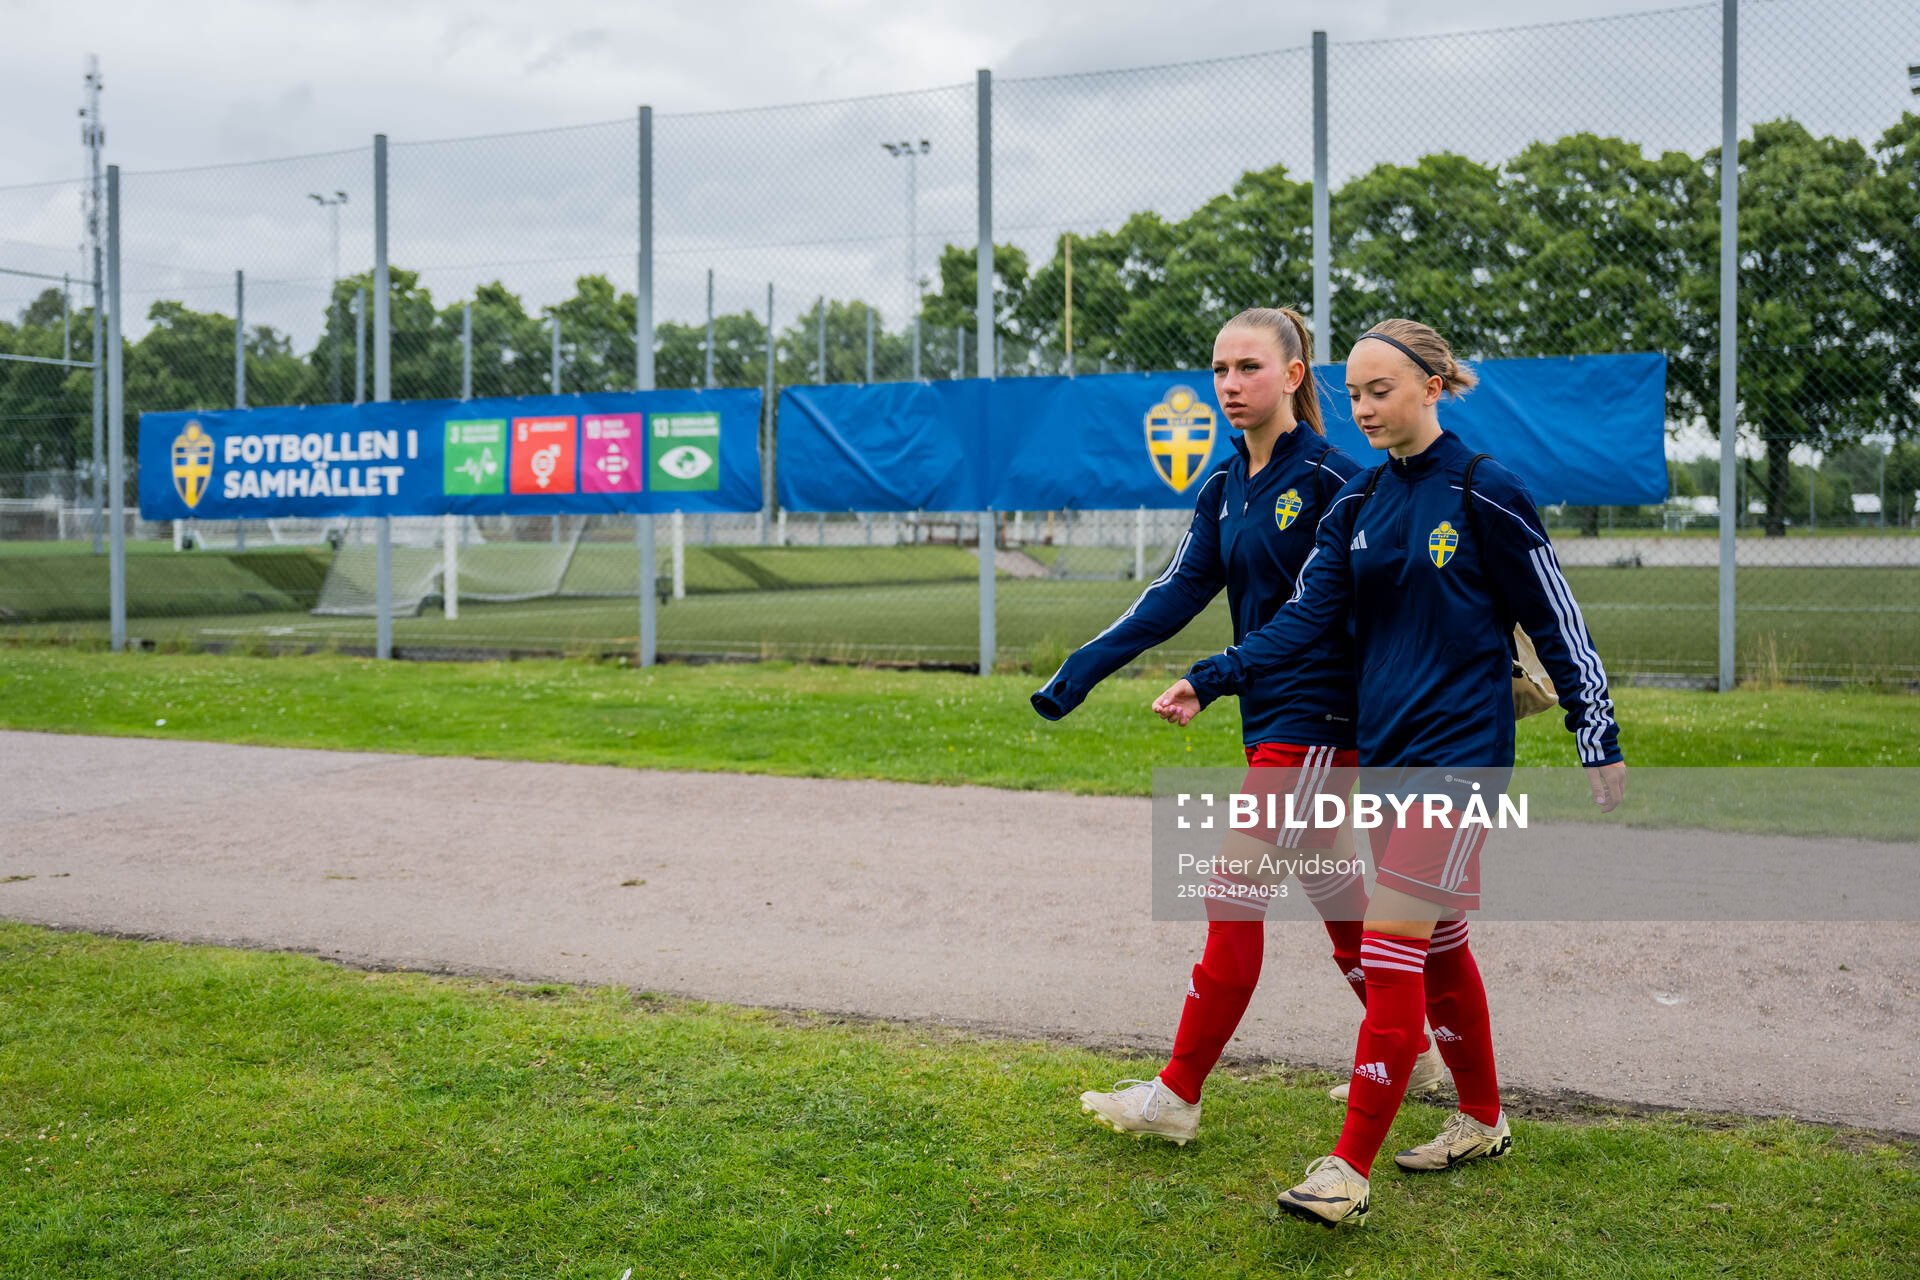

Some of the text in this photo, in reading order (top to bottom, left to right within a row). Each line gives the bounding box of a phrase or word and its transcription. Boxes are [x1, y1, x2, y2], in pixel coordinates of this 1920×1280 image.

[224, 429, 418, 465] FOTBOLLEN I
[222, 462, 404, 499] SAMHÄLLET
[1355, 1068, 1392, 1085] adidas
